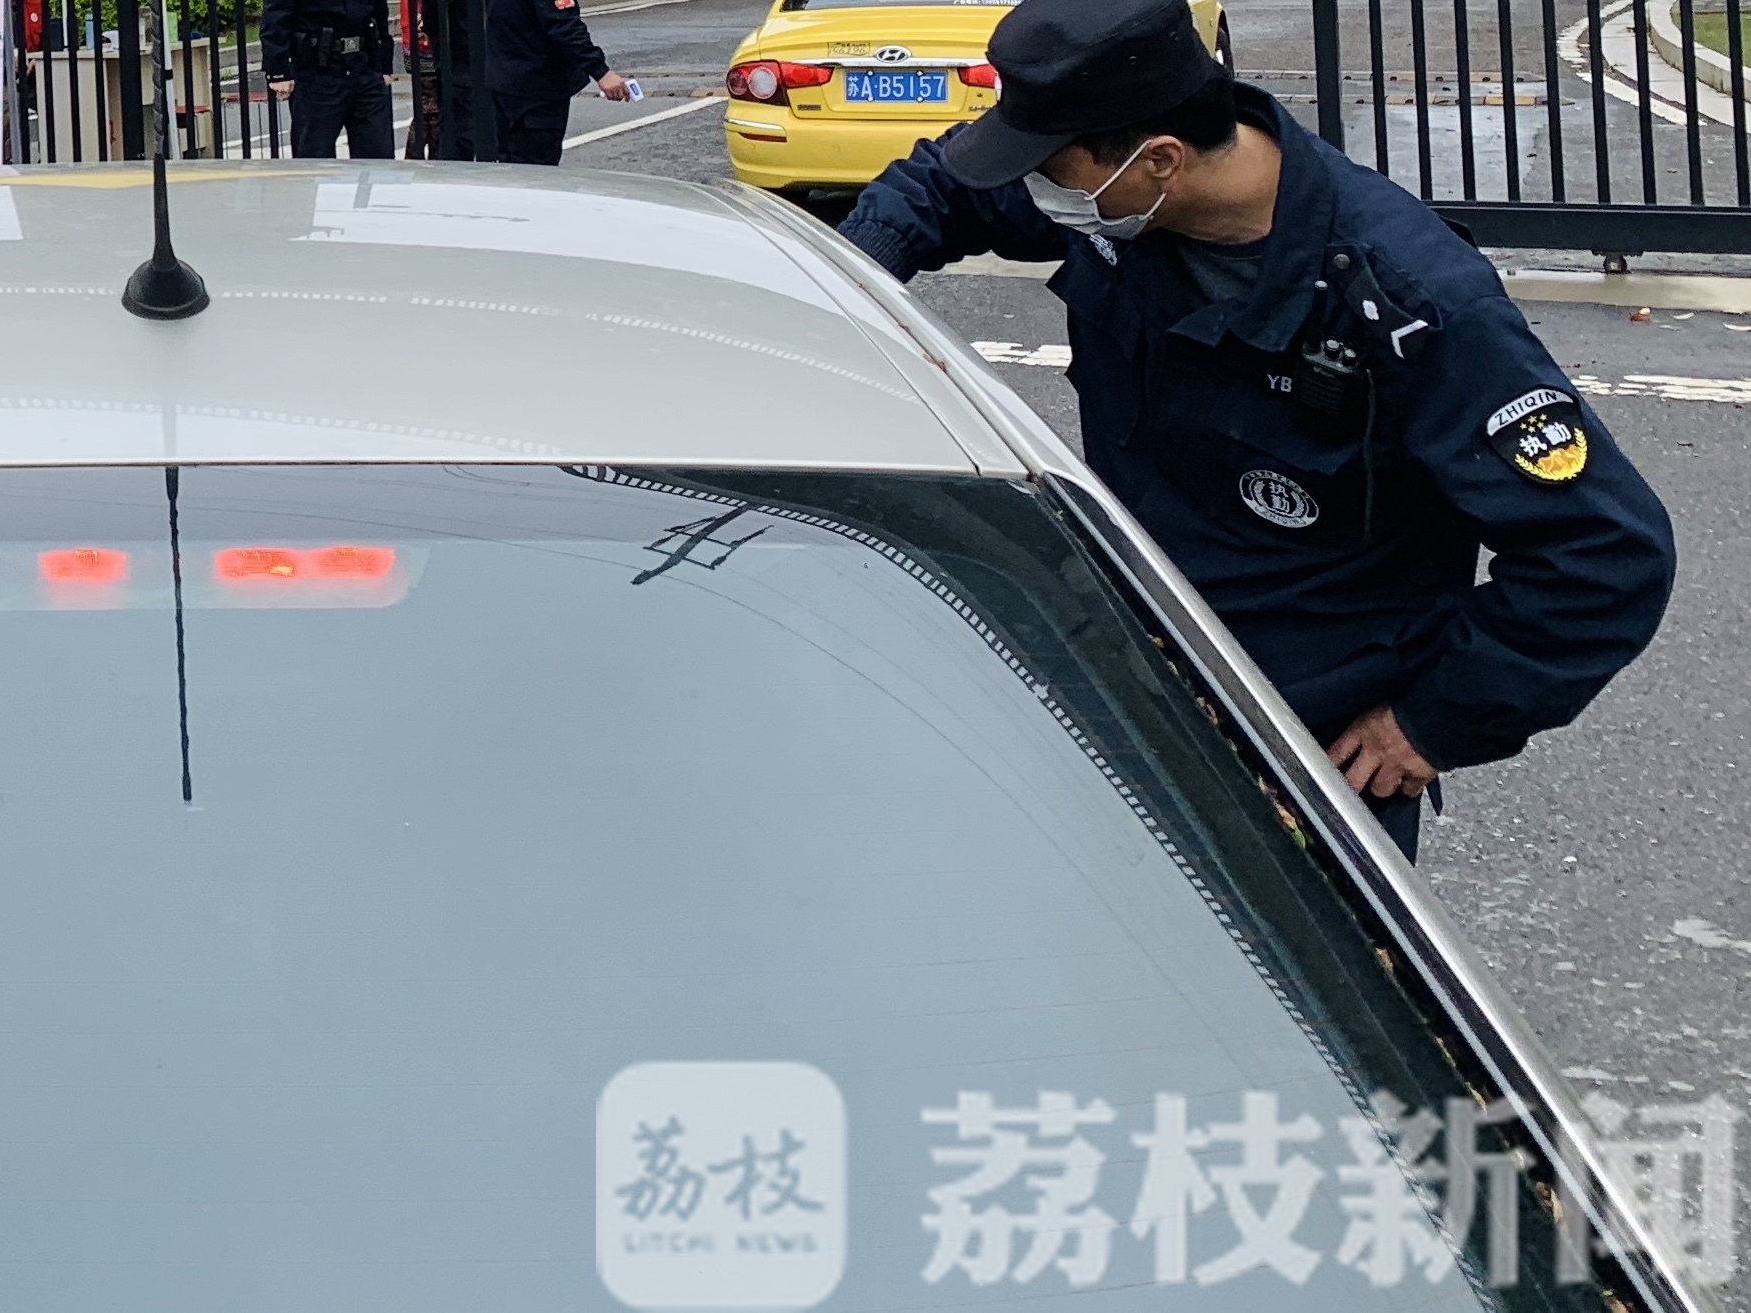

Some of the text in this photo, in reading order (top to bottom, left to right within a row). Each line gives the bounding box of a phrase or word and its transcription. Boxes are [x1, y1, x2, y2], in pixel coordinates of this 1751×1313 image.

[1266, 373, 1293, 393] YB
[1495, 391, 1558, 426] ZHIQIN
[1519, 421, 1573, 458] 执勤
